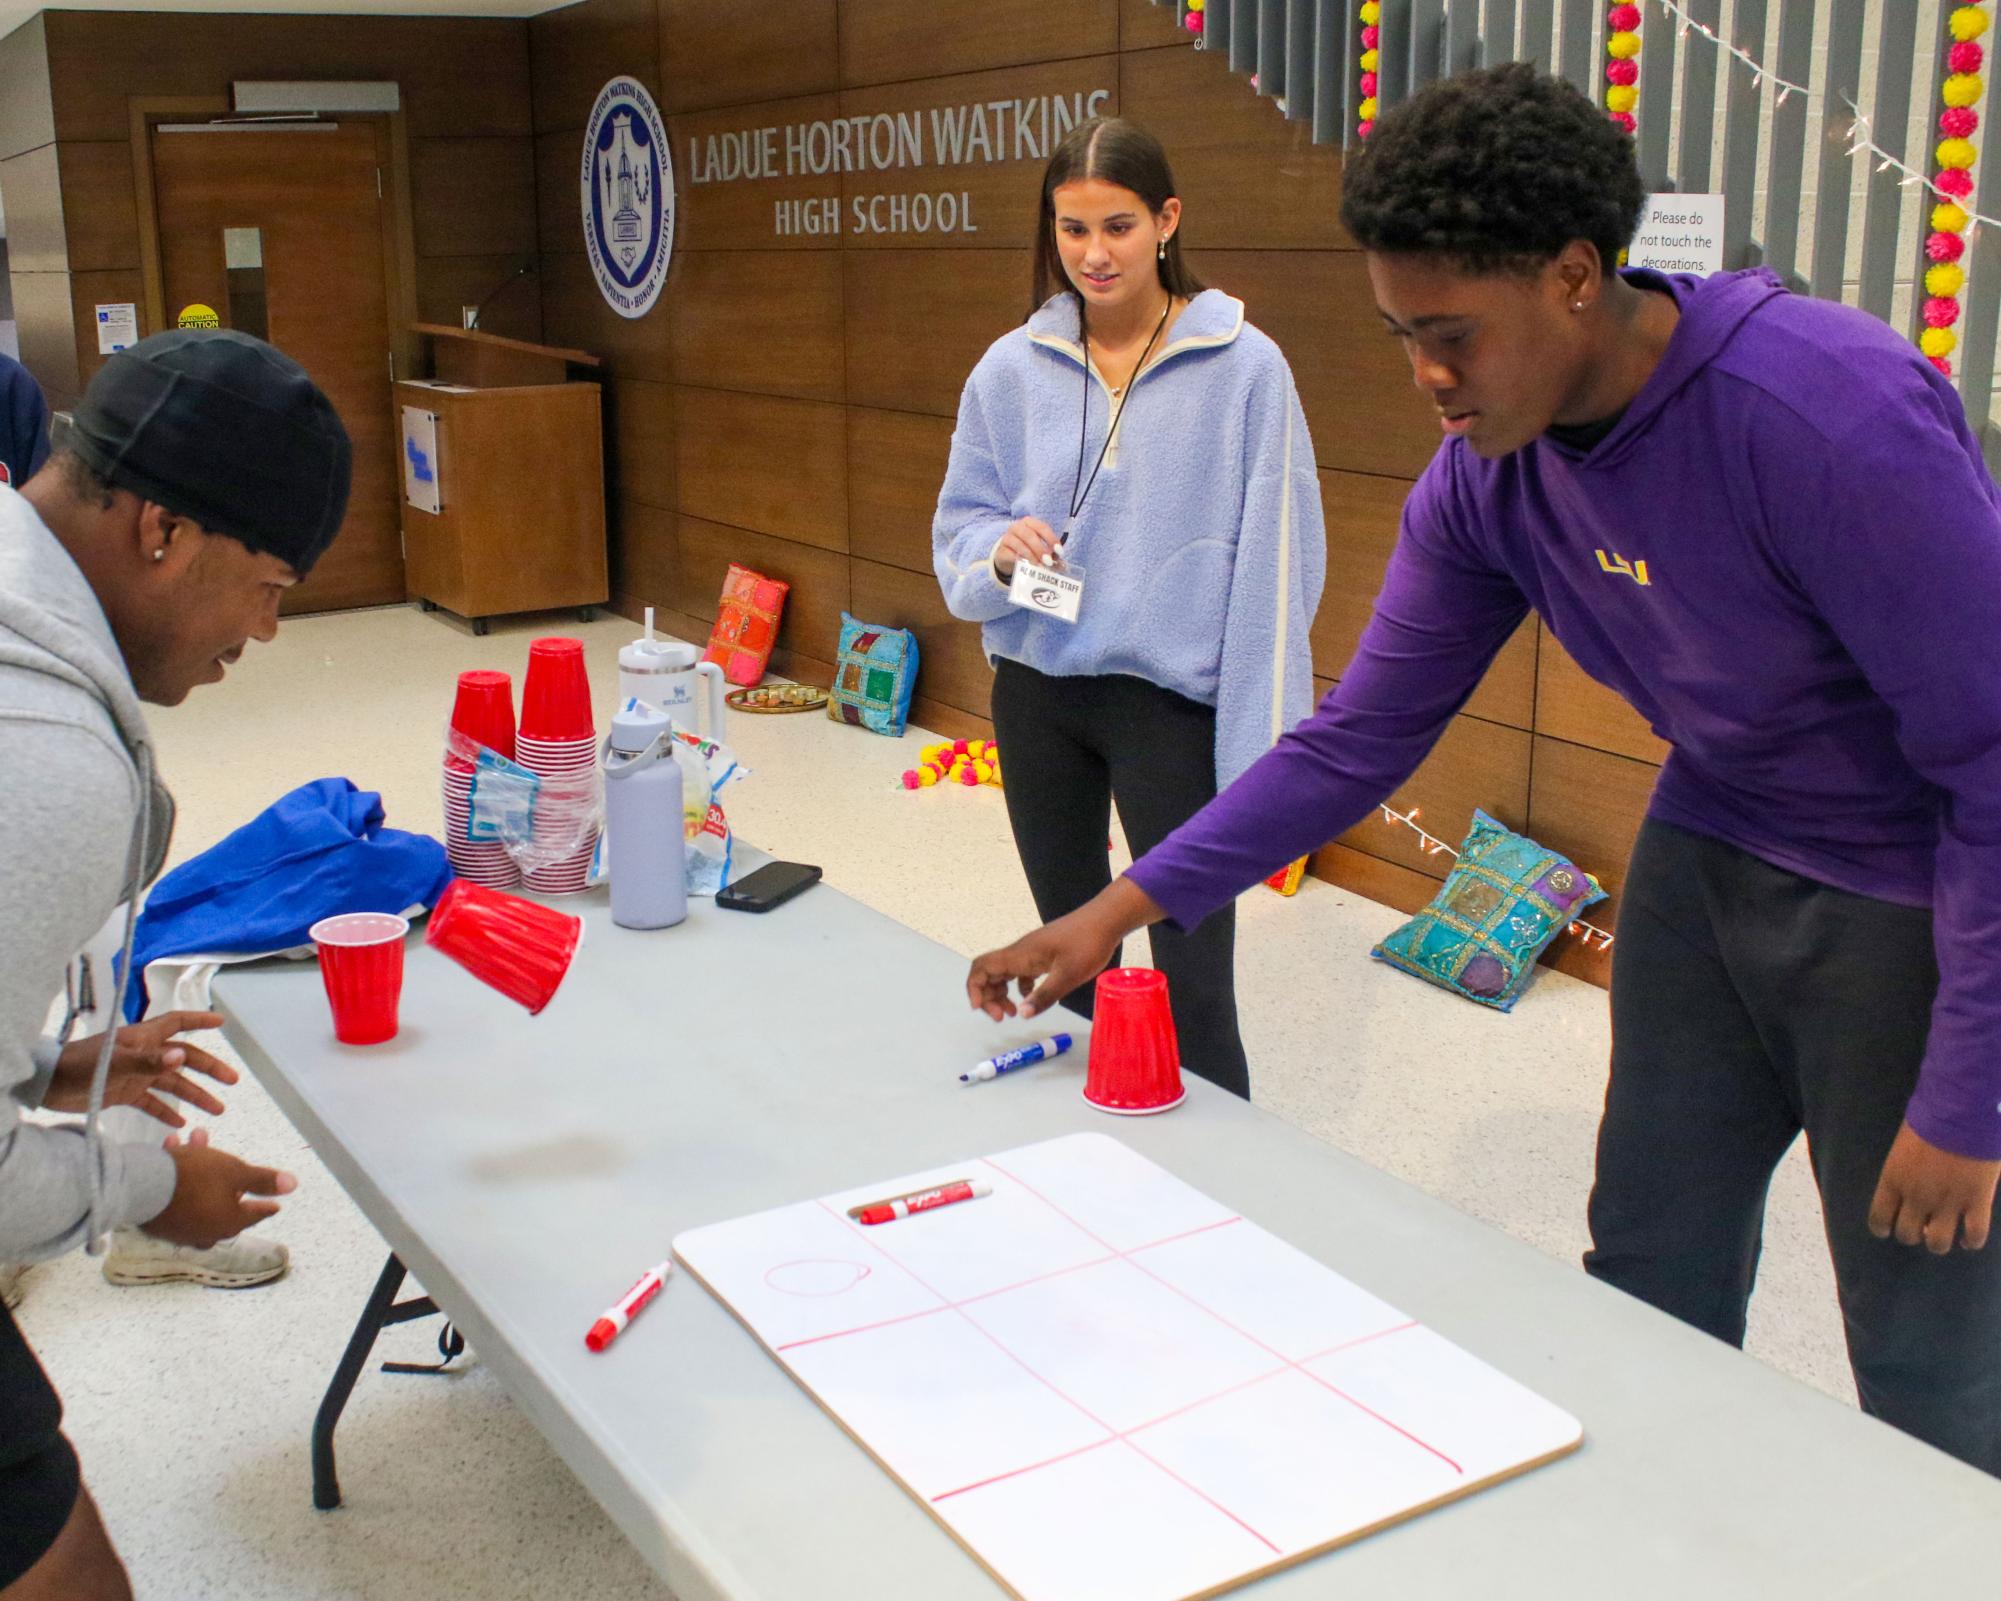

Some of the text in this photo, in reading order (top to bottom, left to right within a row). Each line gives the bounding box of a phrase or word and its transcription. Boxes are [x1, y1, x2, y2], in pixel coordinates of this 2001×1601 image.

[583, 82, 668, 182] LADUE HORTON WATKINS HIGH SCHOOL
[690, 127, 778, 183] LADUE
[786, 111, 922, 176] HORTON
[775, 192, 977, 235] HIGH SCHOOL
[1652, 211, 1703, 224] Please do
[1640, 234, 1712, 249] not touch the
[1641, 256, 1706, 271] decorations.
[634, 280, 656, 309] HONOR
[178, 320, 219, 329] CAUTION
[1060, 581, 1079, 592] STAFF
